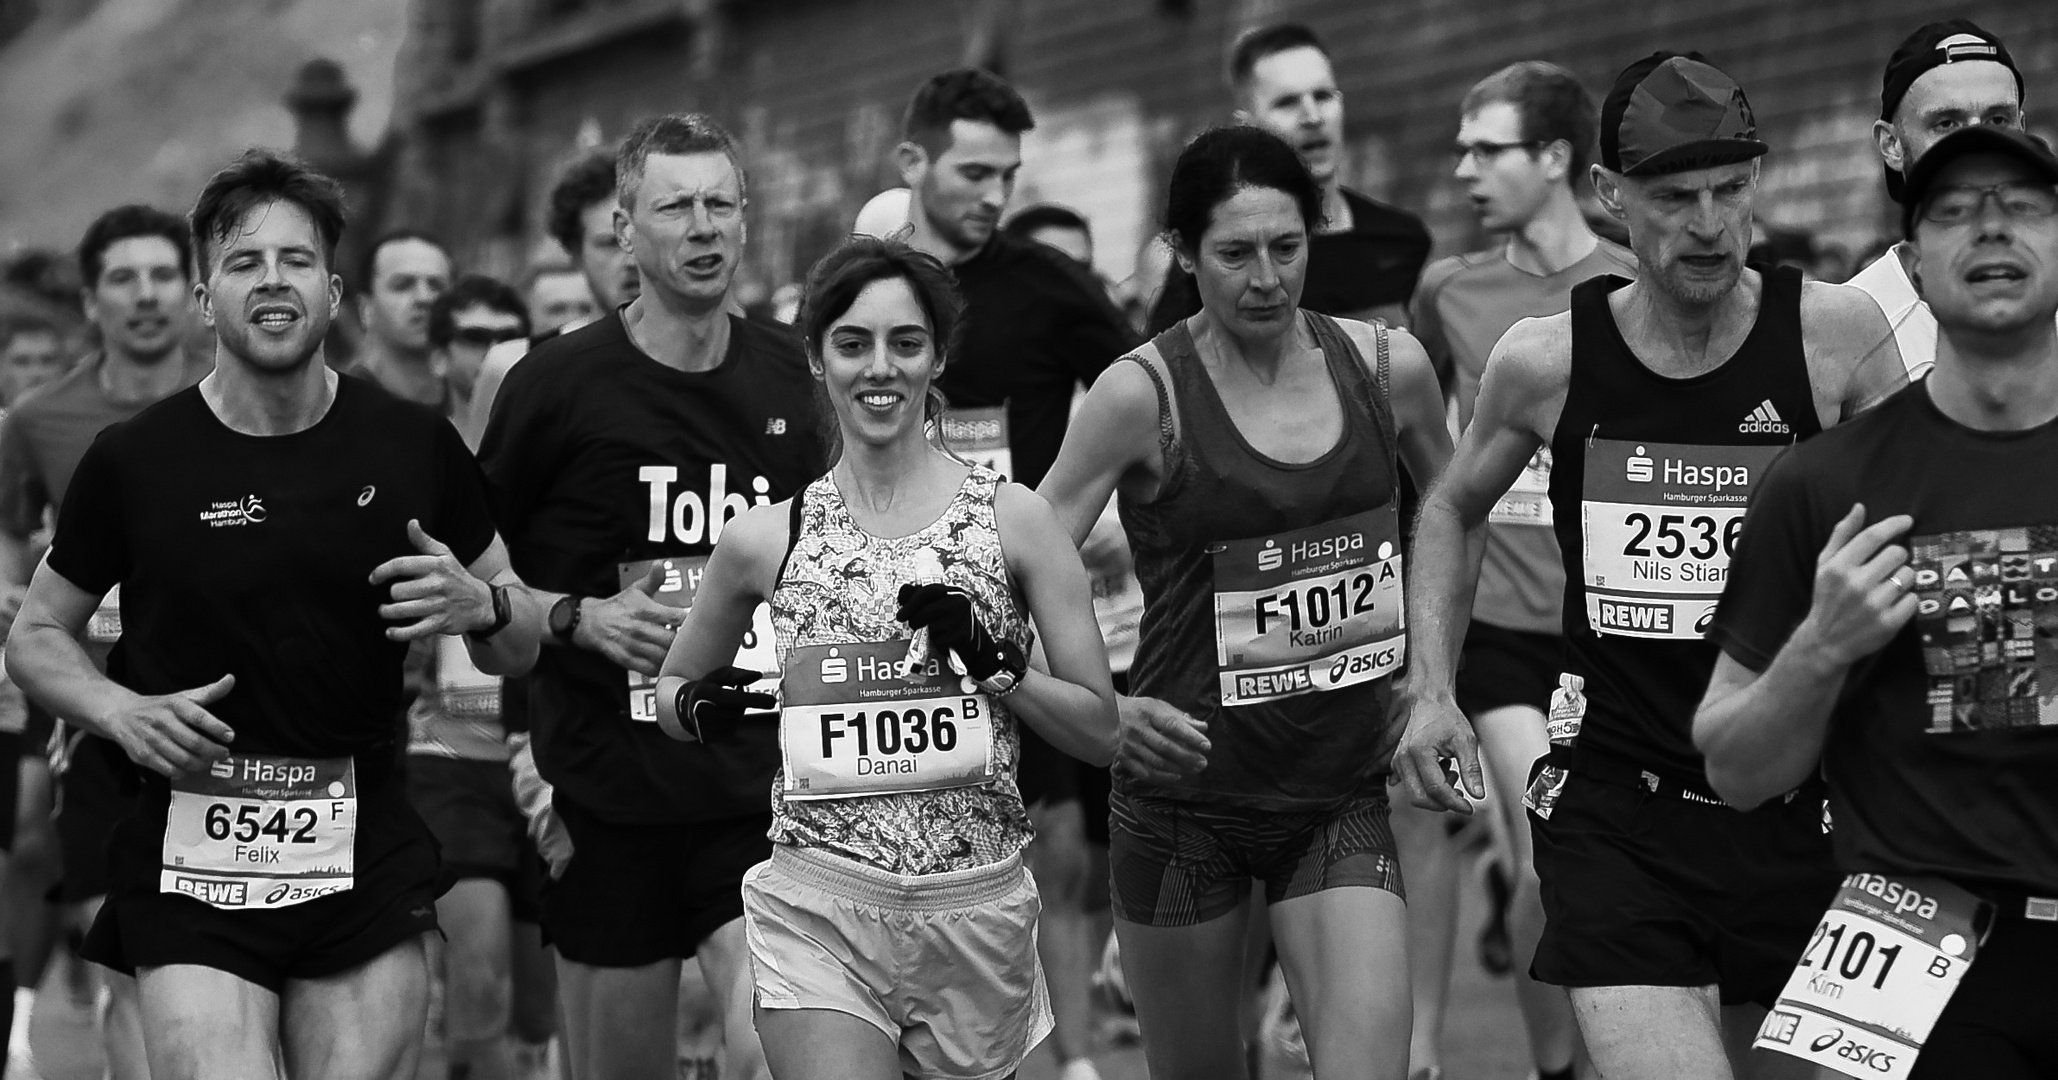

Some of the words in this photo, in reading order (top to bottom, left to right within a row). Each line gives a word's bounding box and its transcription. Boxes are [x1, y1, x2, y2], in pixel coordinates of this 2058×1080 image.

[1739, 420, 1790, 434] adidas
[1663, 458, 1749, 491] Haspa
[1663, 492, 1707, 503] Hamburger
[1708, 493, 1749, 503] Sparkasse
[200, 509, 242, 520] Marathon
[1291, 532, 1364, 563] Haspa
[1291, 563, 1330, 577] Hamburger
[1331, 556, 1366, 571] Sparkasse
[1379, 562, 1395, 583] A
[1633, 560, 1672, 582] Nils
[1256, 573, 1375, 634] F1012
[1602, 603, 1669, 629] REWE
[1290, 625, 1343, 648] Katrin
[856, 656, 940, 685] Hasa
[1350, 647, 1395, 674] asics
[859, 687, 902, 698] Hamburger
[903, 685, 941, 697] Sparkasse
[1239, 669, 1310, 696] REWE
[961, 698, 980, 720] B
[820, 707, 957, 759] F1036
[243, 759, 316, 788] Haspa
[857, 755, 918, 776] Danai
[205, 803, 318, 844] 6542
[331, 802, 344, 821] F
[235, 845, 279, 864] Felix
[1799, 920, 1903, 990] 2101
[1926, 954, 1951, 979] B
[1806, 972, 1844, 1000] Kim
[1837, 1041, 1897, 1072] asics
